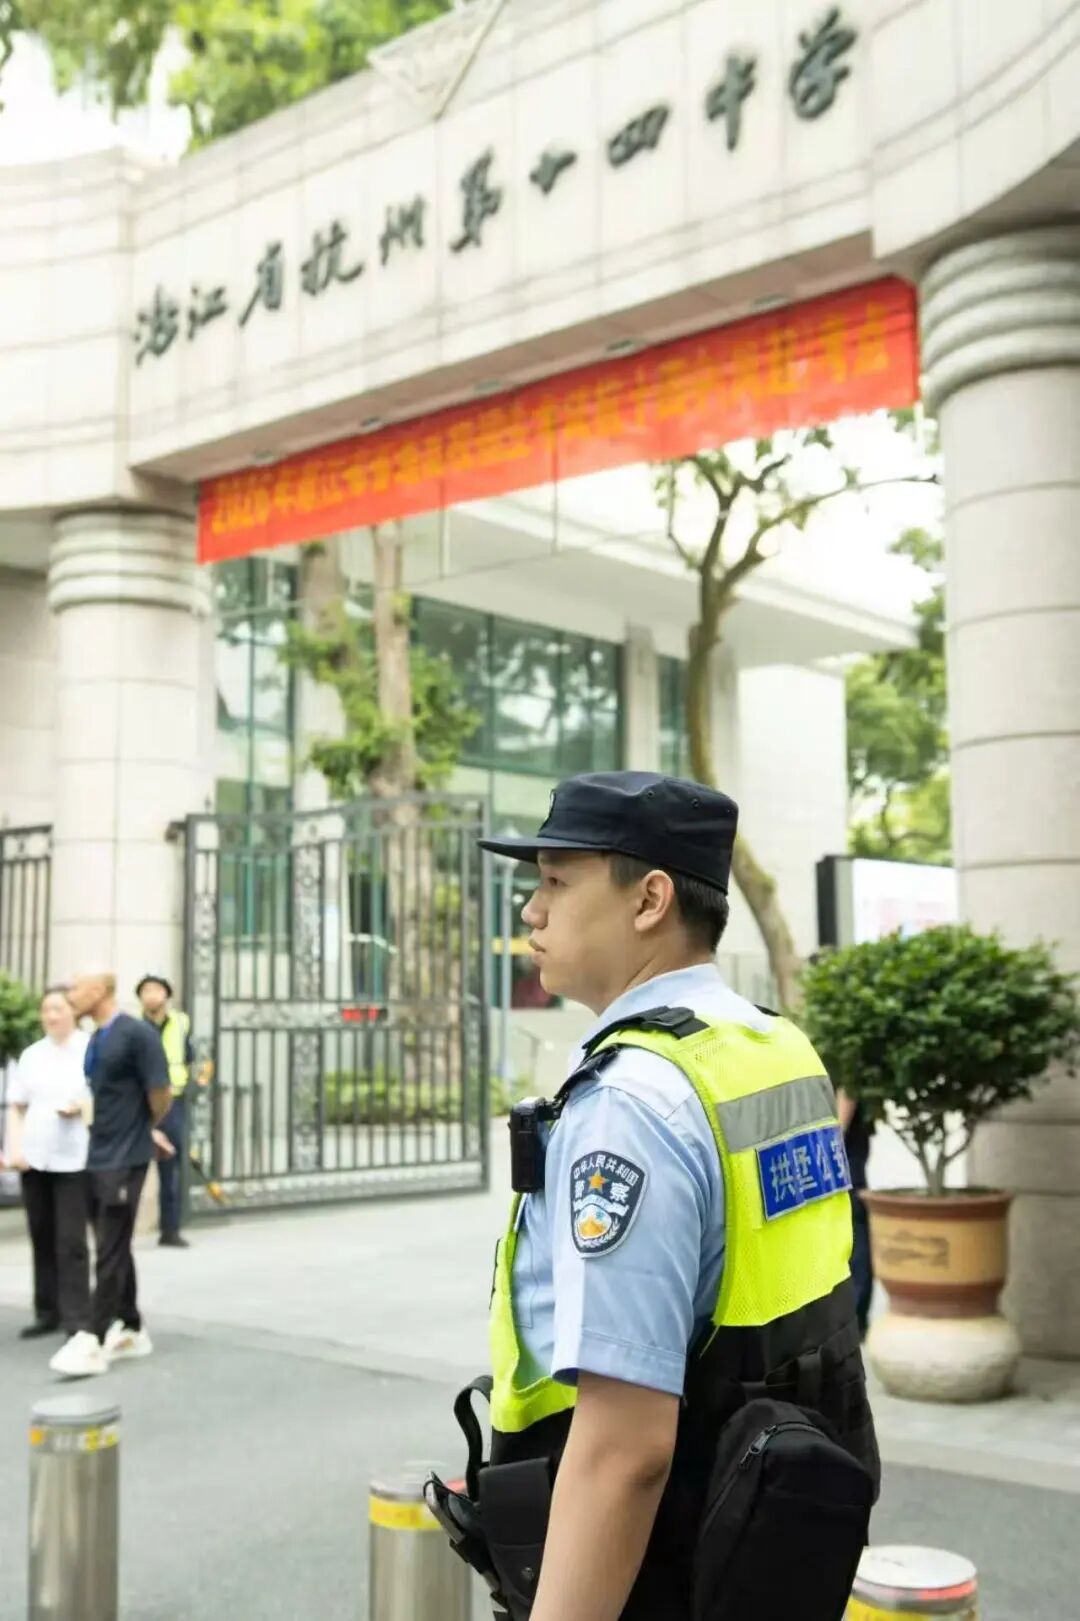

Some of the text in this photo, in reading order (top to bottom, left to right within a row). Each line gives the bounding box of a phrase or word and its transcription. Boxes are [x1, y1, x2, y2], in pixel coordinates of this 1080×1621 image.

[134, 6, 859, 366] 浙江省杭州第十四中学
[573, 1154, 640, 1187] 中华人民共和国
[574, 1180, 631, 1204] 警察
